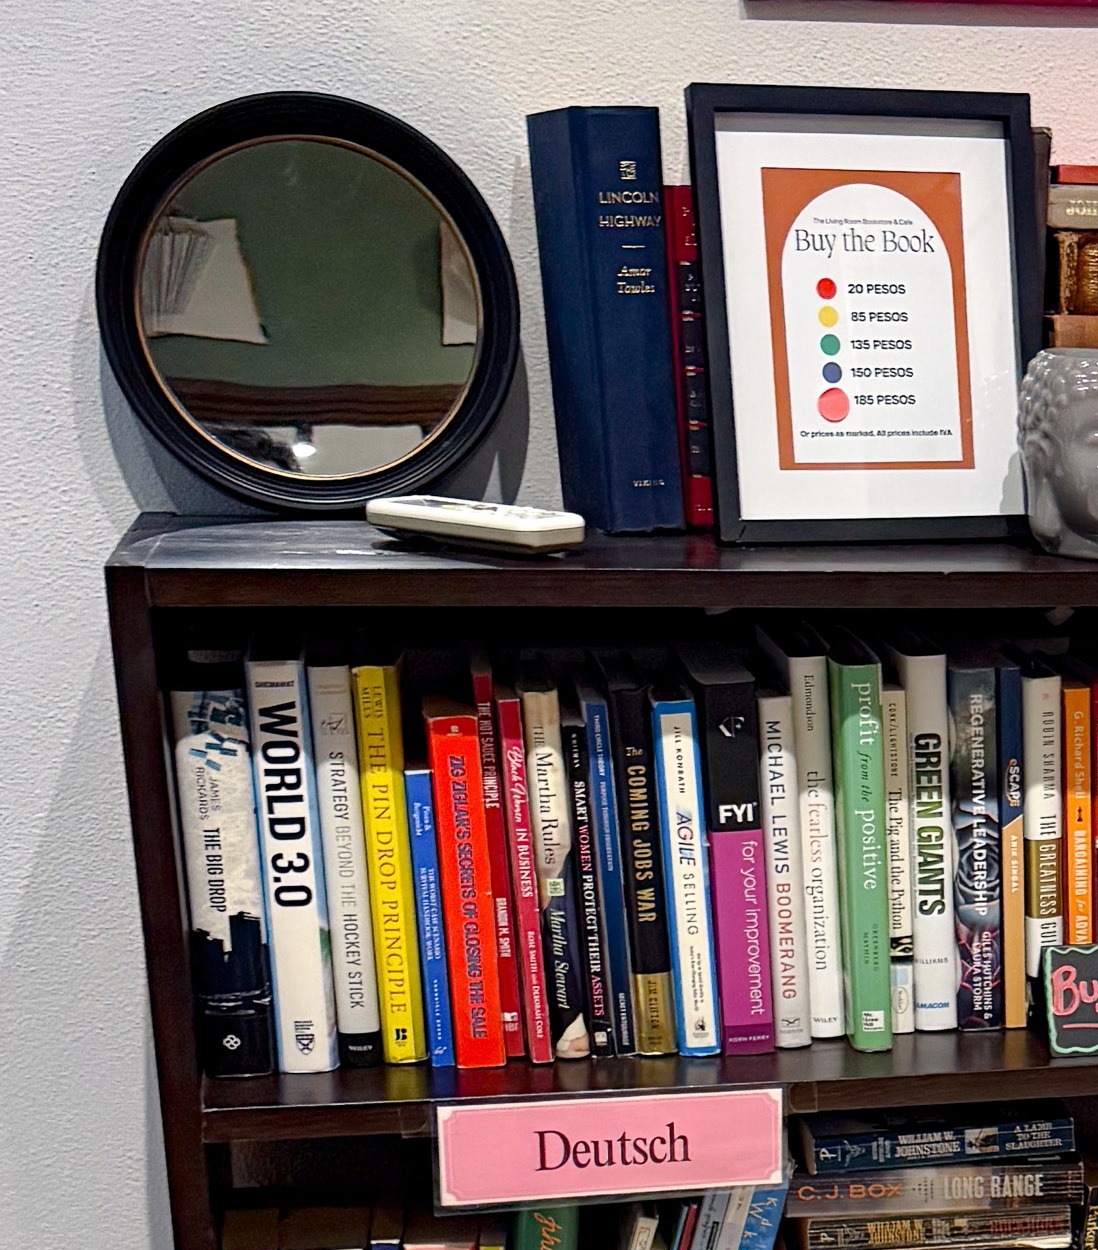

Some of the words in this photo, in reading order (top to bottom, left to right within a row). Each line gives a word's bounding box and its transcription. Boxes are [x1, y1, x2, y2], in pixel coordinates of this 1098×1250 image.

[599, 191, 660, 204] LINCOLN
[599, 215, 661, 228] HIGHWAY
[795, 229, 836, 258] Buy
[842, 228, 876, 251] the
[882, 229, 936, 253] Book
[617, 265, 652, 278] Amor
[847, 284, 864, 294] 20
[867, 284, 907, 294] PESOS
[851, 312, 866, 322] 85
[869, 312, 909, 322] PESOS
[850, 340, 871, 350] 135
[873, 340, 913, 350] PESOS
[850, 368, 872, 377] 150
[874, 368, 914, 377] PESOS
[854, 395, 875, 405] 185
[876, 395, 916, 405] PESOS
[803, 674, 814, 732] Edmondson
[850, 682, 879, 747] profit
[258, 701, 305, 842] WORLD
[366, 728, 386, 776] THE
[625, 747, 643, 757] The
[765, 720, 785, 807] MICHAEL
[968, 693, 987, 815] REGENERATIVE
[328, 751, 349, 820] STRATEGY
[534, 751, 554, 811] Martha
[574, 780, 588, 821] SMART
[627, 766, 648, 831] COMING
[807, 770, 819, 798] the
[913, 732, 942, 824] GREEN
[371, 783, 392, 821] PIN
[718, 804, 754, 824] FYI
[1039, 814, 1058, 836] THE
[202, 827, 222, 852] THE
[334, 826, 354, 878] BEYOND
[541, 814, 556, 866] Rules
[578, 824, 593, 871] WOMEN
[675, 811, 697, 866] AGILE
[740, 840, 757, 866] for
[772, 814, 790, 875] LEWIS
[808, 799, 823, 867] fearless
[855, 809, 878, 891] positive
[204, 856, 224, 879] BIG
[271, 852, 314, 908] 3.0
[375, 830, 396, 891] DROP
[633, 836, 652, 882] JOBS
[917, 826, 947, 917] GIANTS
[970, 815, 989, 917] LEADERSHIP
[1039, 843, 1058, 918] GREATNESS
[206, 881, 227, 913] DROP
[339, 883, 356, 908] THE
[582, 872, 598, 929] PROTECT
[637, 886, 657, 923] WAR
[682, 872, 699, 936] SELLING
[744, 869, 758, 906] your
[342, 913, 360, 969] HOCKEY
[549, 909, 566, 955] Martha
[775, 882, 797, 1000] BOOMERANG
[806, 869, 828, 971] organization
[382, 900, 407, 1014] PRINCIPLE
[588, 931, 602, 972] THEIR
[746, 907, 767, 1015] improvement
[347, 971, 365, 1010] STICK
[554, 958, 571, 1010] Stewart
[591, 975, 606, 1016] ASSETS
[534, 1122, 693, 1172] Deutsch
[797, 1185, 844, 1200] C.J.
[849, 1184, 901, 1199] BOX
[943, 1177, 985, 1200] LONG
[990, 1174, 1044, 1200] RANGE
